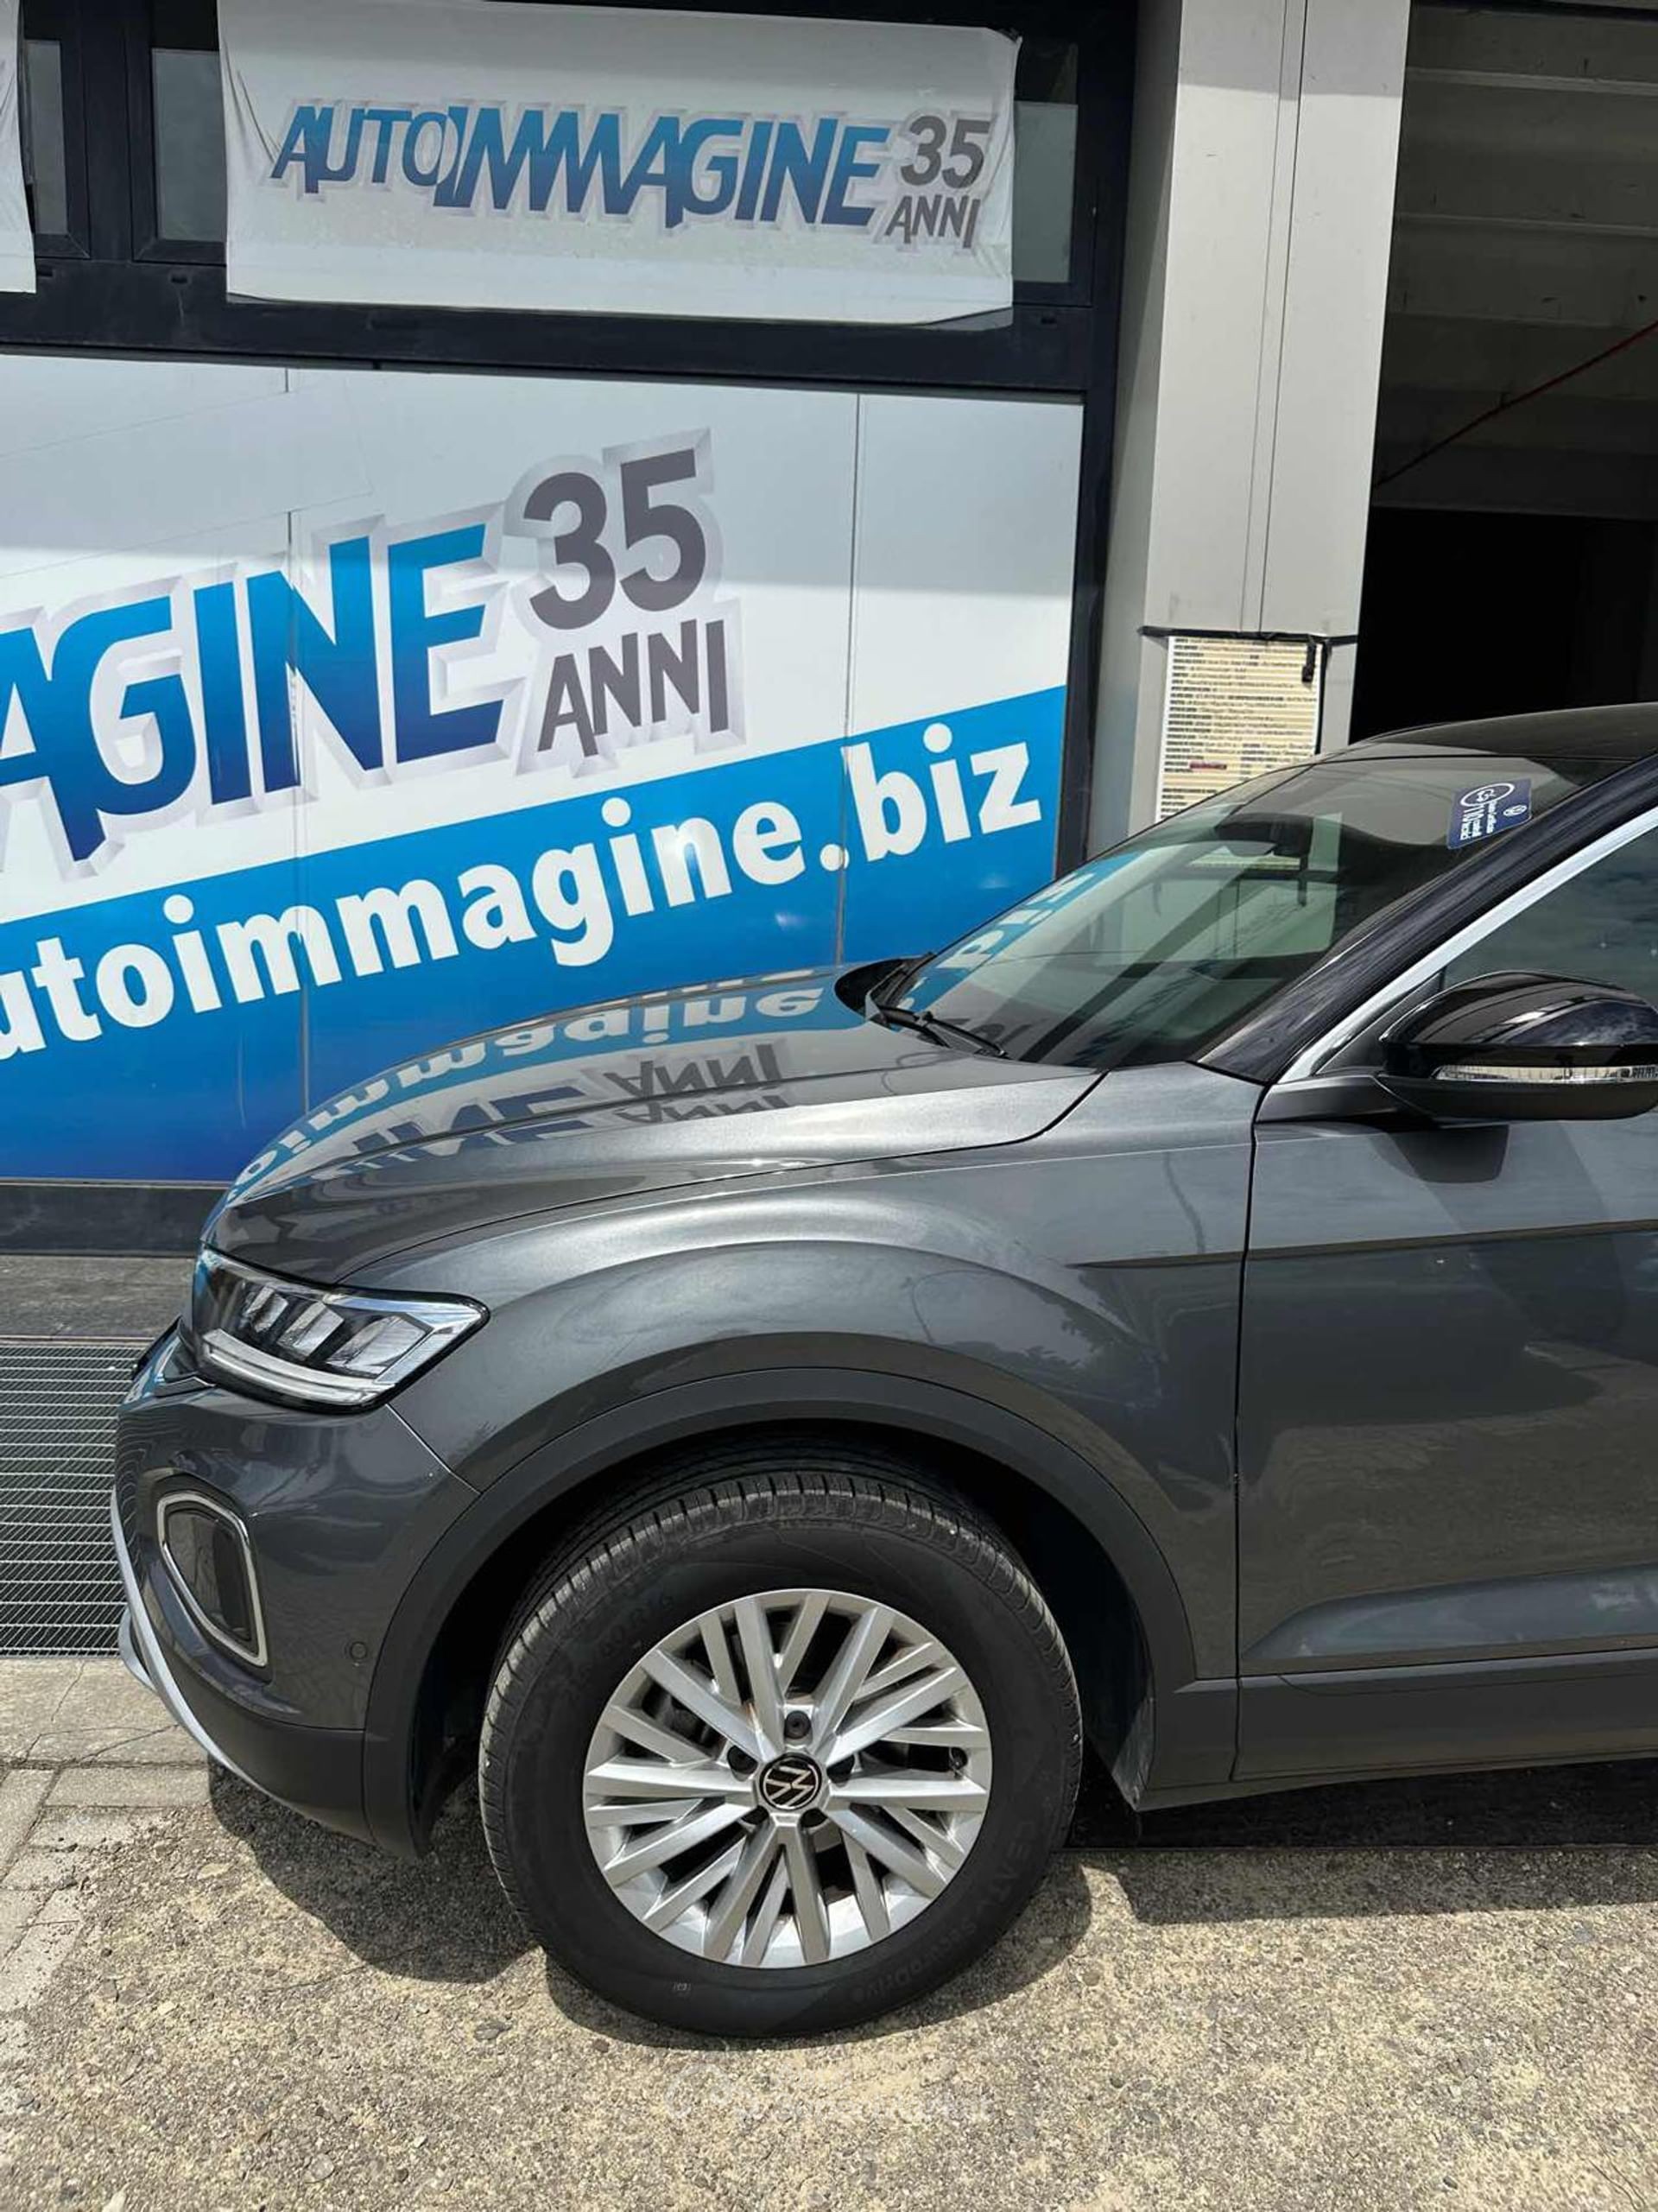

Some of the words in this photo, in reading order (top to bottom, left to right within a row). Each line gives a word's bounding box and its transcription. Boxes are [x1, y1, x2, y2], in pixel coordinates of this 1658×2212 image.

[270, 105, 891, 228] AUTOIMMAGINE
[900, 116, 995, 190] 35
[886, 194, 981, 250] ANNI
[523, 447, 706, 631] 35
[537, 618, 729, 757] ANNI
